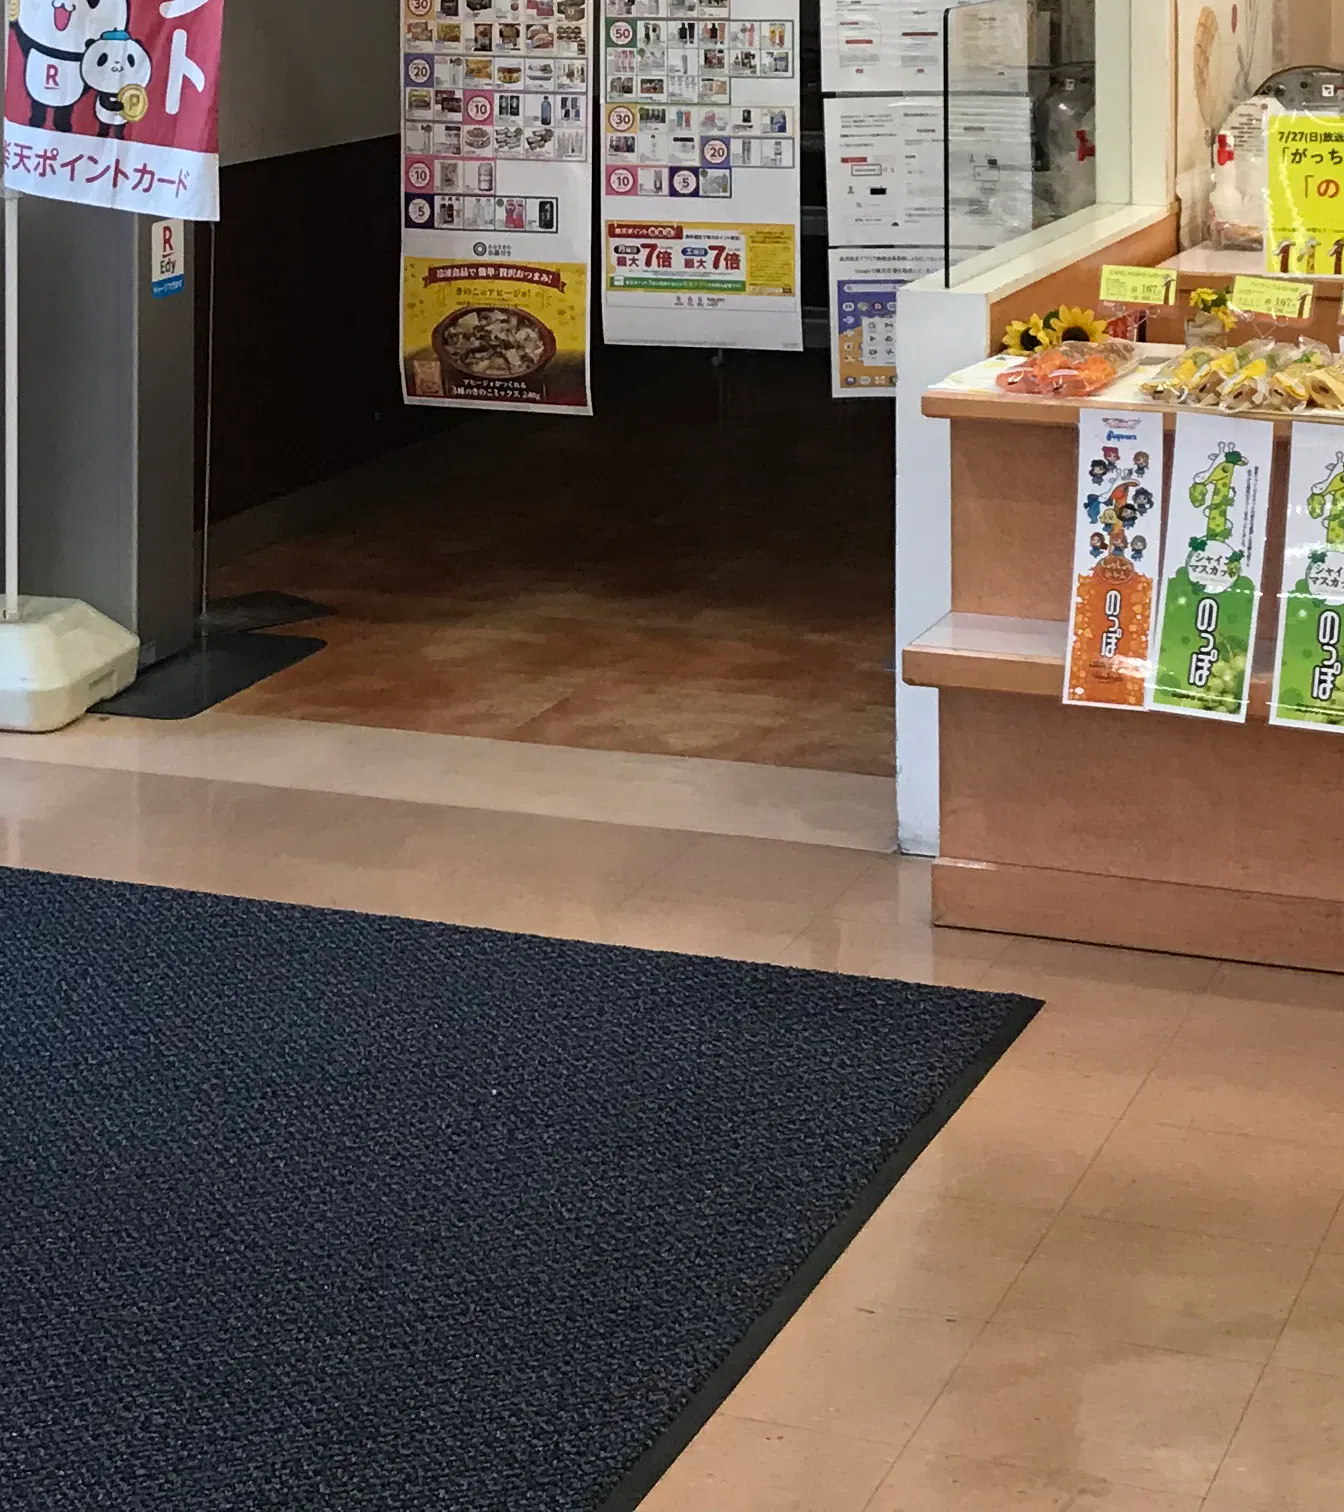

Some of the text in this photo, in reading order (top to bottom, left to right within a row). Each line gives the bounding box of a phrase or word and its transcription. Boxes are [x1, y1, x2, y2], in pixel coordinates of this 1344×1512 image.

[160, 258, 177, 274] Edy
[1190, 565, 1230, 577] マスカッ
[1101, 590, 1122, 658] のっぽ
[1189, 598, 1218, 687] のっぽ
[1312, 610, 1342, 700] のっぽ
